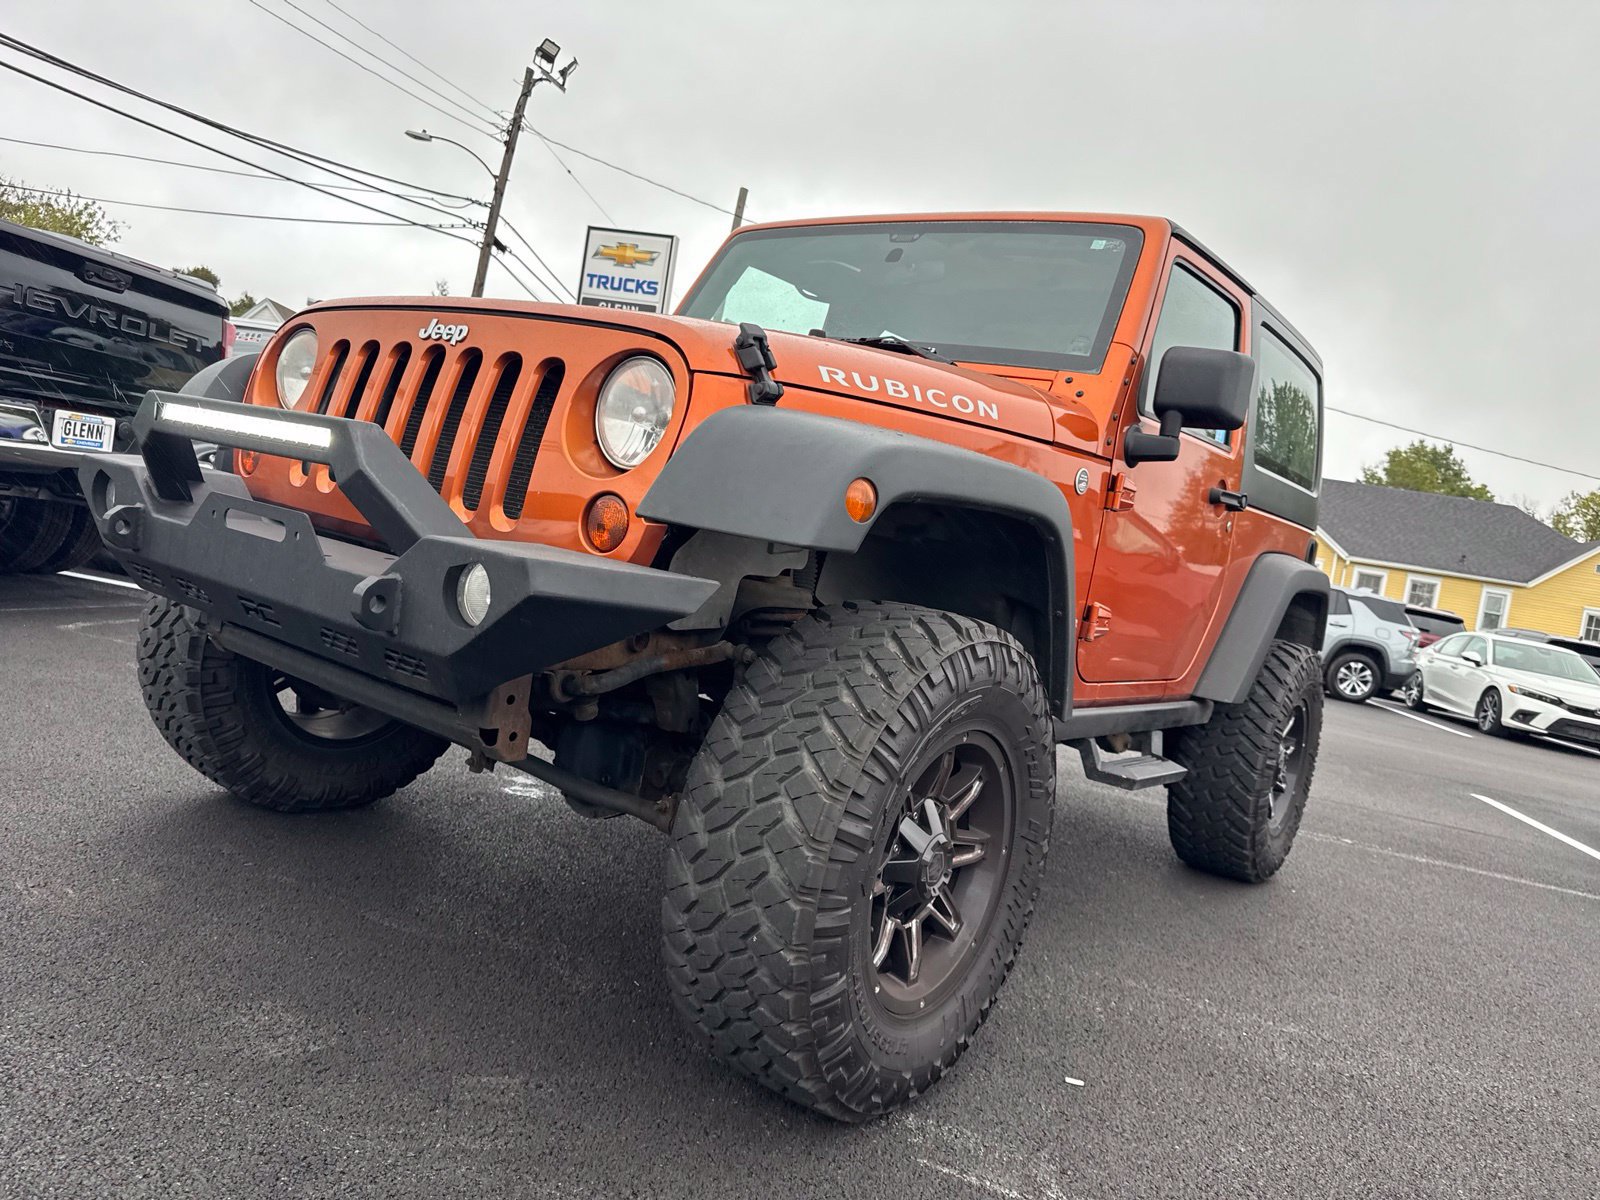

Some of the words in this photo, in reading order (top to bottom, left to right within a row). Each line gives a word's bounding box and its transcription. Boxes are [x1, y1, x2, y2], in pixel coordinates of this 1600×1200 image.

[587, 273, 659, 296] TRUCKS
[419, 318, 468, 345] Jeep
[817, 365, 999, 420] RUBICON
[64, 421, 103, 440] GLENN
